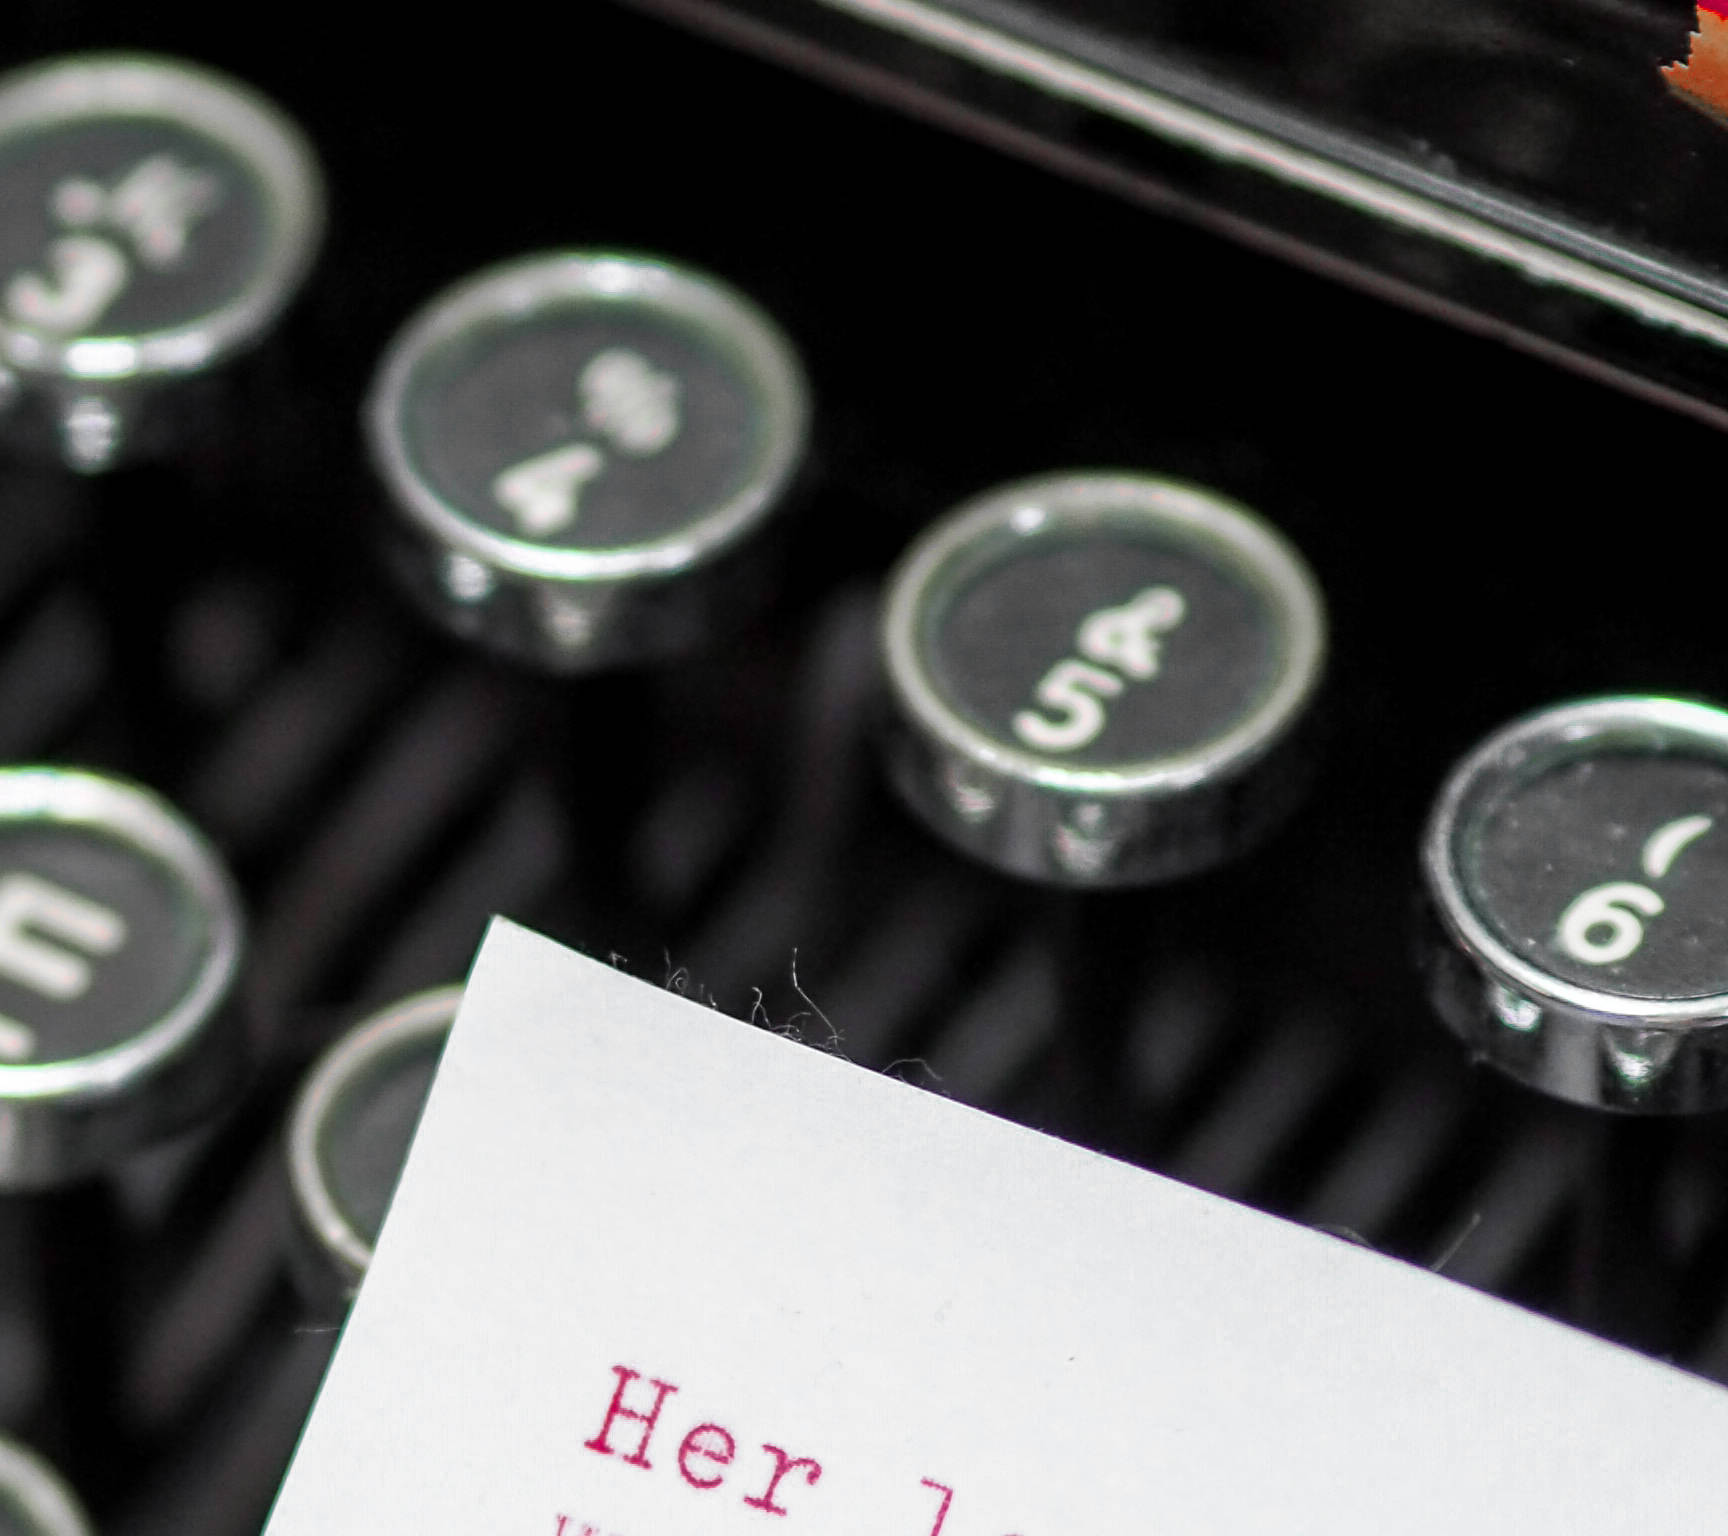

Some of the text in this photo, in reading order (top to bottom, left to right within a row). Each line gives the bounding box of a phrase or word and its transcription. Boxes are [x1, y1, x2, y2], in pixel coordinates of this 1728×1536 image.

[5, 233, 128, 334] 3
[492, 441, 604, 536] 4
[1012, 657, 1125, 754] 5
[1553, 880, 1666, 967] 6
[584, 1364, 823, 1518] Her
